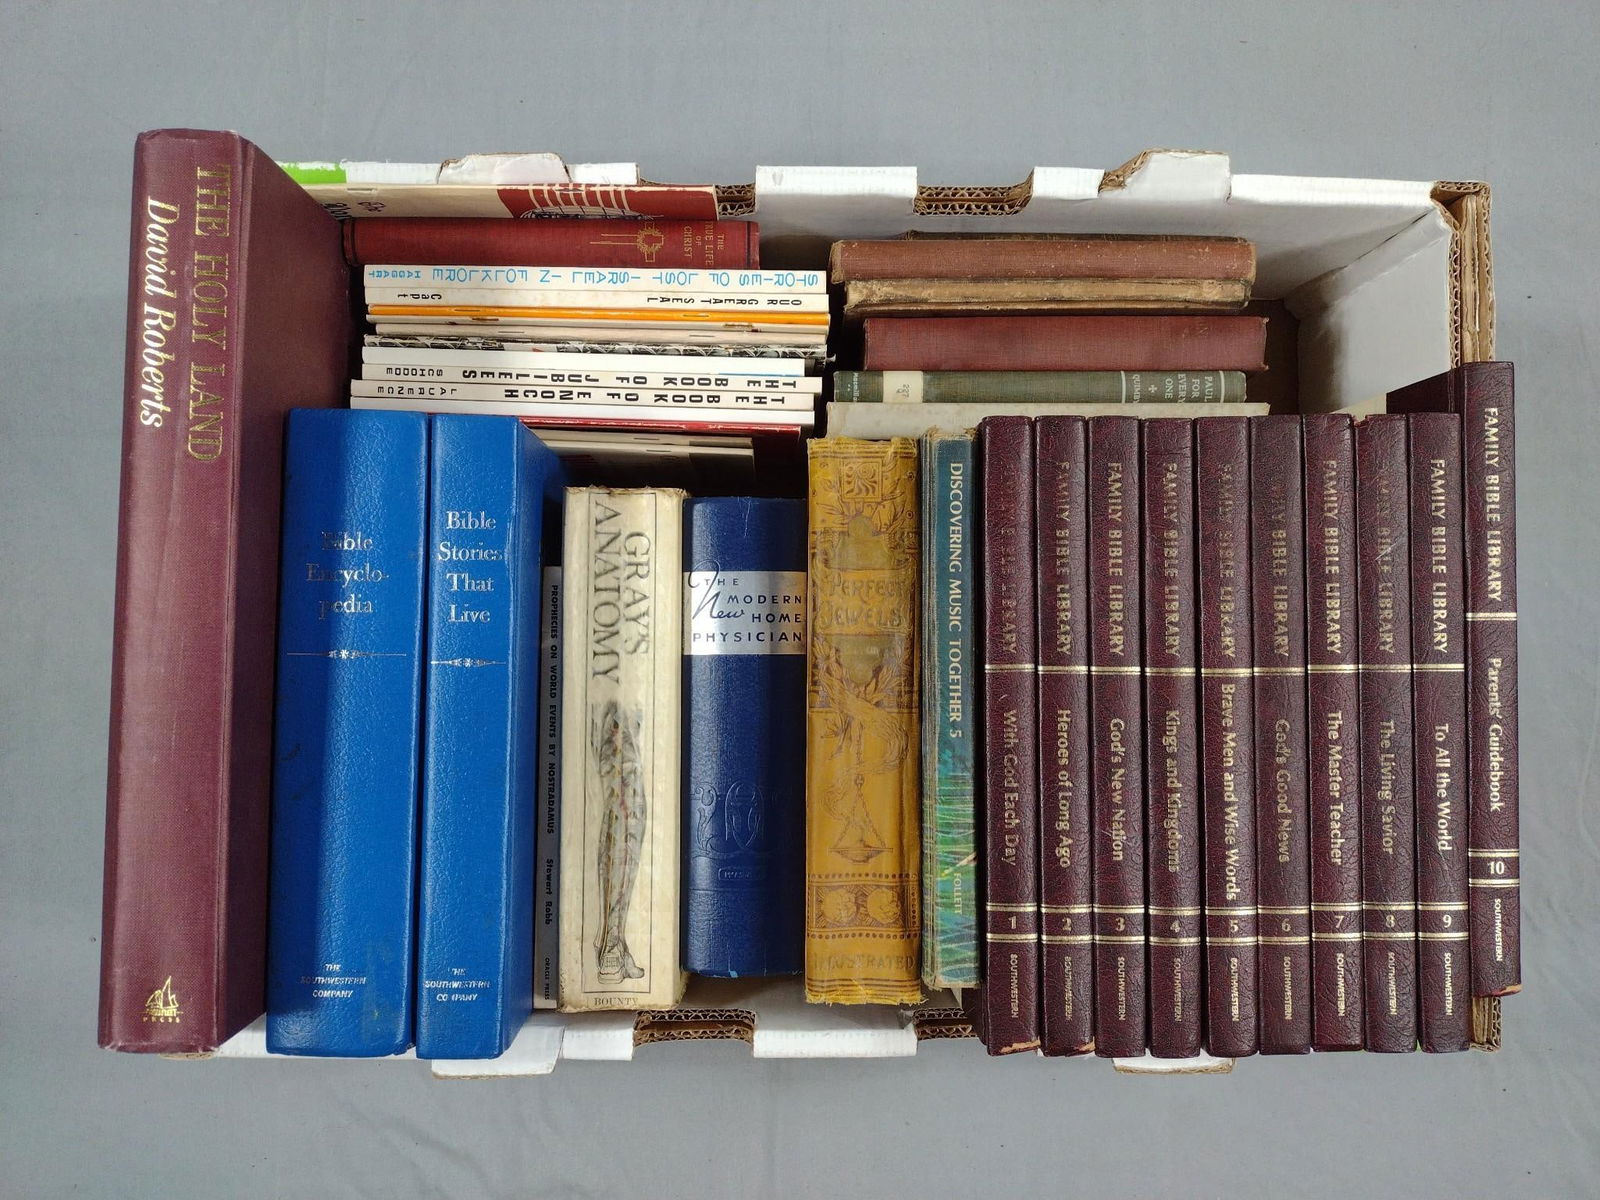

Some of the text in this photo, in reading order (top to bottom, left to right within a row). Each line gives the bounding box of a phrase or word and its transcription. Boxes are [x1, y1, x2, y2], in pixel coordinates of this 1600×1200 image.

[684, 226, 692, 258] CHRIST
[696, 236, 702, 246] OF
[705, 245, 714, 265] LIFE
[368, 270, 420, 279] HAGGART
[432, 268, 818, 287] STORIES OF LOST ISRAEL IN FOLKLORE
[140, 196, 180, 428] David Roberts
[188, 165, 231, 461] THE HOLY LAND
[647, 296, 694, 304] SEAL
[700, 298, 759, 306] GREAT
[378, 386, 457, 396] LAURENCE
[386, 367, 443, 377] SCHODDE
[462, 370, 796, 389] THE BOOK OF JUBILEES
[1164, 378, 1174, 399] ONE
[1191, 379, 1200, 398] FOR
[1204, 376, 1214, 402] PAUL
[504, 389, 785, 405] THE BOOK OF ENOCH
[446, 510, 496, 530] Bible
[949, 463, 964, 573] DISCOVERING
[1484, 406, 1502, 602] FAMILY BIBLE LIBRARY
[321, 531, 373, 551] Bible
[437, 541, 503, 562] Stories
[1108, 462, 1124, 656] FAMILY BIBLE LIBRARY
[1163, 462, 1180, 658] FAMILY BIBLE LIBRARY
[1272, 530, 1287, 576] BIBLE
[1322, 459, 1342, 654] FAMILY BIBLE LIBRARY
[1430, 459, 1448, 653] FAMILY BIBLE LIBRARY
[306, 563, 390, 588] Encyclo-
[446, 572, 494, 592] That
[592, 502, 622, 685] ANATOMY
[687, 558, 745, 620] New
[705, 578, 739, 586] THE
[319, 594, 374, 620] pedia
[448, 604, 491, 623] Live
[726, 594, 802, 604] MODERN
[751, 613, 802, 623] HOME
[948, 578, 963, 632] MUSIC
[1056, 584, 1072, 656] LIBRARY
[1273, 585, 1288, 657] LIBRARY
[1378, 583, 1394, 654] LIBRARY
[692, 632, 802, 642] PHYSICIAN
[1220, 586, 1236, 658] LIBRARY
[948, 636, 963, 722] TOGETHER
[547, 584, 558, 834] PROPHECIES ON WORLD EVENTS BY NOSTRADAMUS
[1488, 658, 1504, 812] Parents' Guidebook
[1001, 710, 1020, 866] With God Each Day
[1055, 709, 1074, 868] Heroes of Long Ago
[1110, 717, 1127, 862] God's New Nation
[1162, 710, 1182, 873] Kings and Kingdoms
[1221, 683, 1241, 902] Brave Men and Wise Words
[1276, 769, 1292, 814] Good
[1327, 711, 1344, 866] The Master Teacher
[1378, 720, 1396, 855] The Living Savior
[1434, 723, 1453, 852] To All the World
[1277, 818, 1292, 864] News
[1490, 860, 1505, 875] 10
[544, 858, 554, 925] Stewart Robb
[952, 872, 964, 914] FOLLETT
[1008, 916, 1017, 930] 1
[1062, 916, 1072, 932] 2
[1115, 917, 1126, 932] 3
[1170, 918, 1181, 933] 4
[1230, 918, 1240, 933] 5
[1281, 919, 1291, 932] 6
[1334, 915, 1343, 928] 7
[1385, 914, 1396, 928] 8
[1442, 914, 1452, 928] 9
[1494, 898, 1502, 962] SOUTHWESTERN
[312, 990, 354, 998] COMPANY
[594, 997, 638, 1006] BOUNTY
[1010, 954, 1019, 1019] SOUTHWESTERN
[1118, 956, 1126, 1021] SOUTHWESTERN
[1173, 958, 1182, 1022] SOUTHWESTERN
[1230, 958, 1240, 1022] SOUTHWESTERN
[1284, 956, 1292, 1020] SOUTHWESTERN
[1336, 952, 1345, 1017] SOUTHWESTERN
[1387, 952, 1397, 1016] SOUTHWESTERN
[1442, 952, 1452, 1016] SOUTHWESTERN
